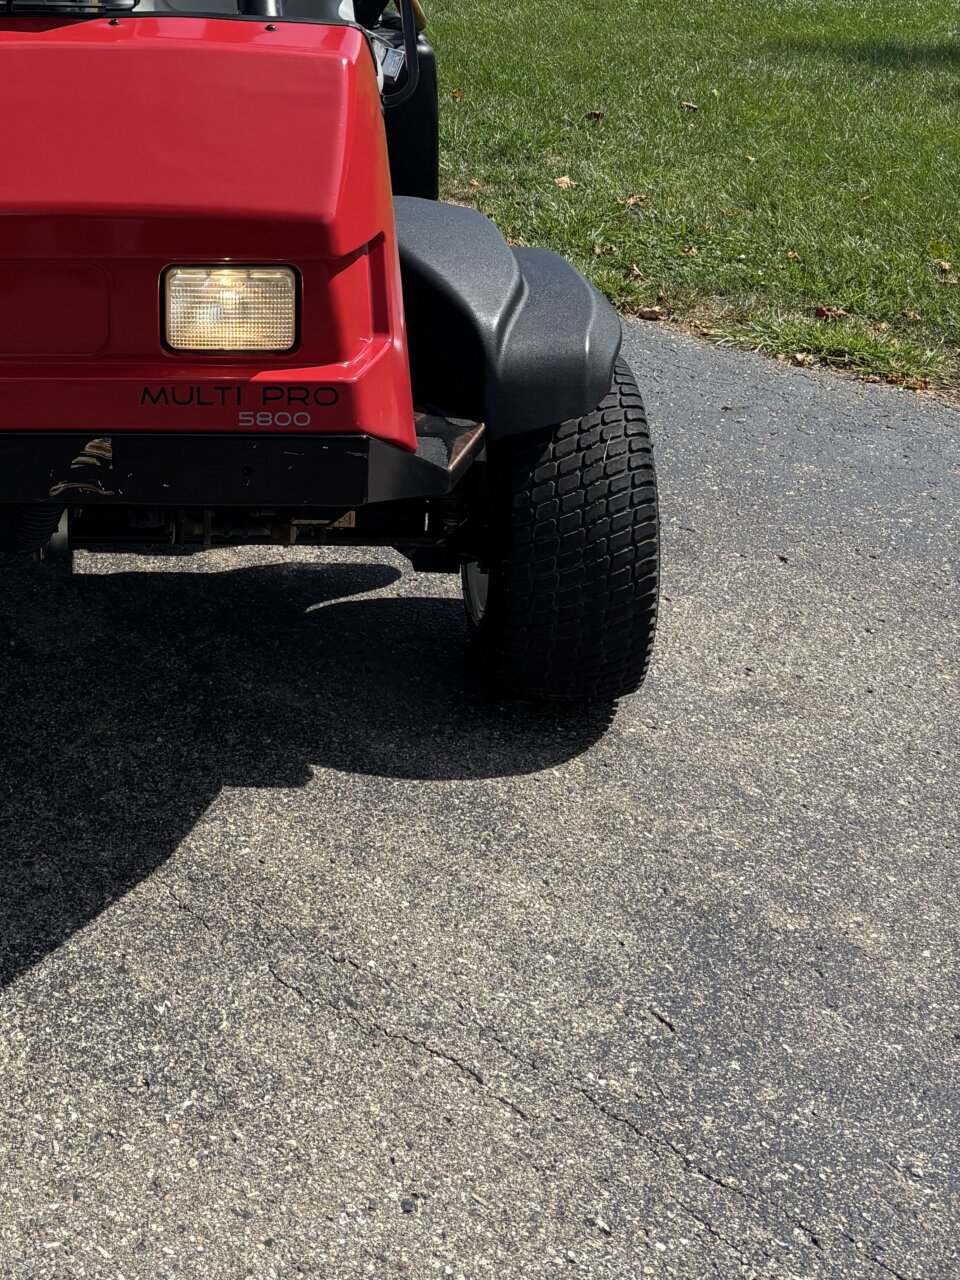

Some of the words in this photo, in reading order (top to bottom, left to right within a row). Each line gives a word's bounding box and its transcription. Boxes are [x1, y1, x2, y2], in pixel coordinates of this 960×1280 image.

[140, 385, 242, 406] MULTI
[262, 385, 340, 407] PRO
[238, 411, 312, 427] 5800
